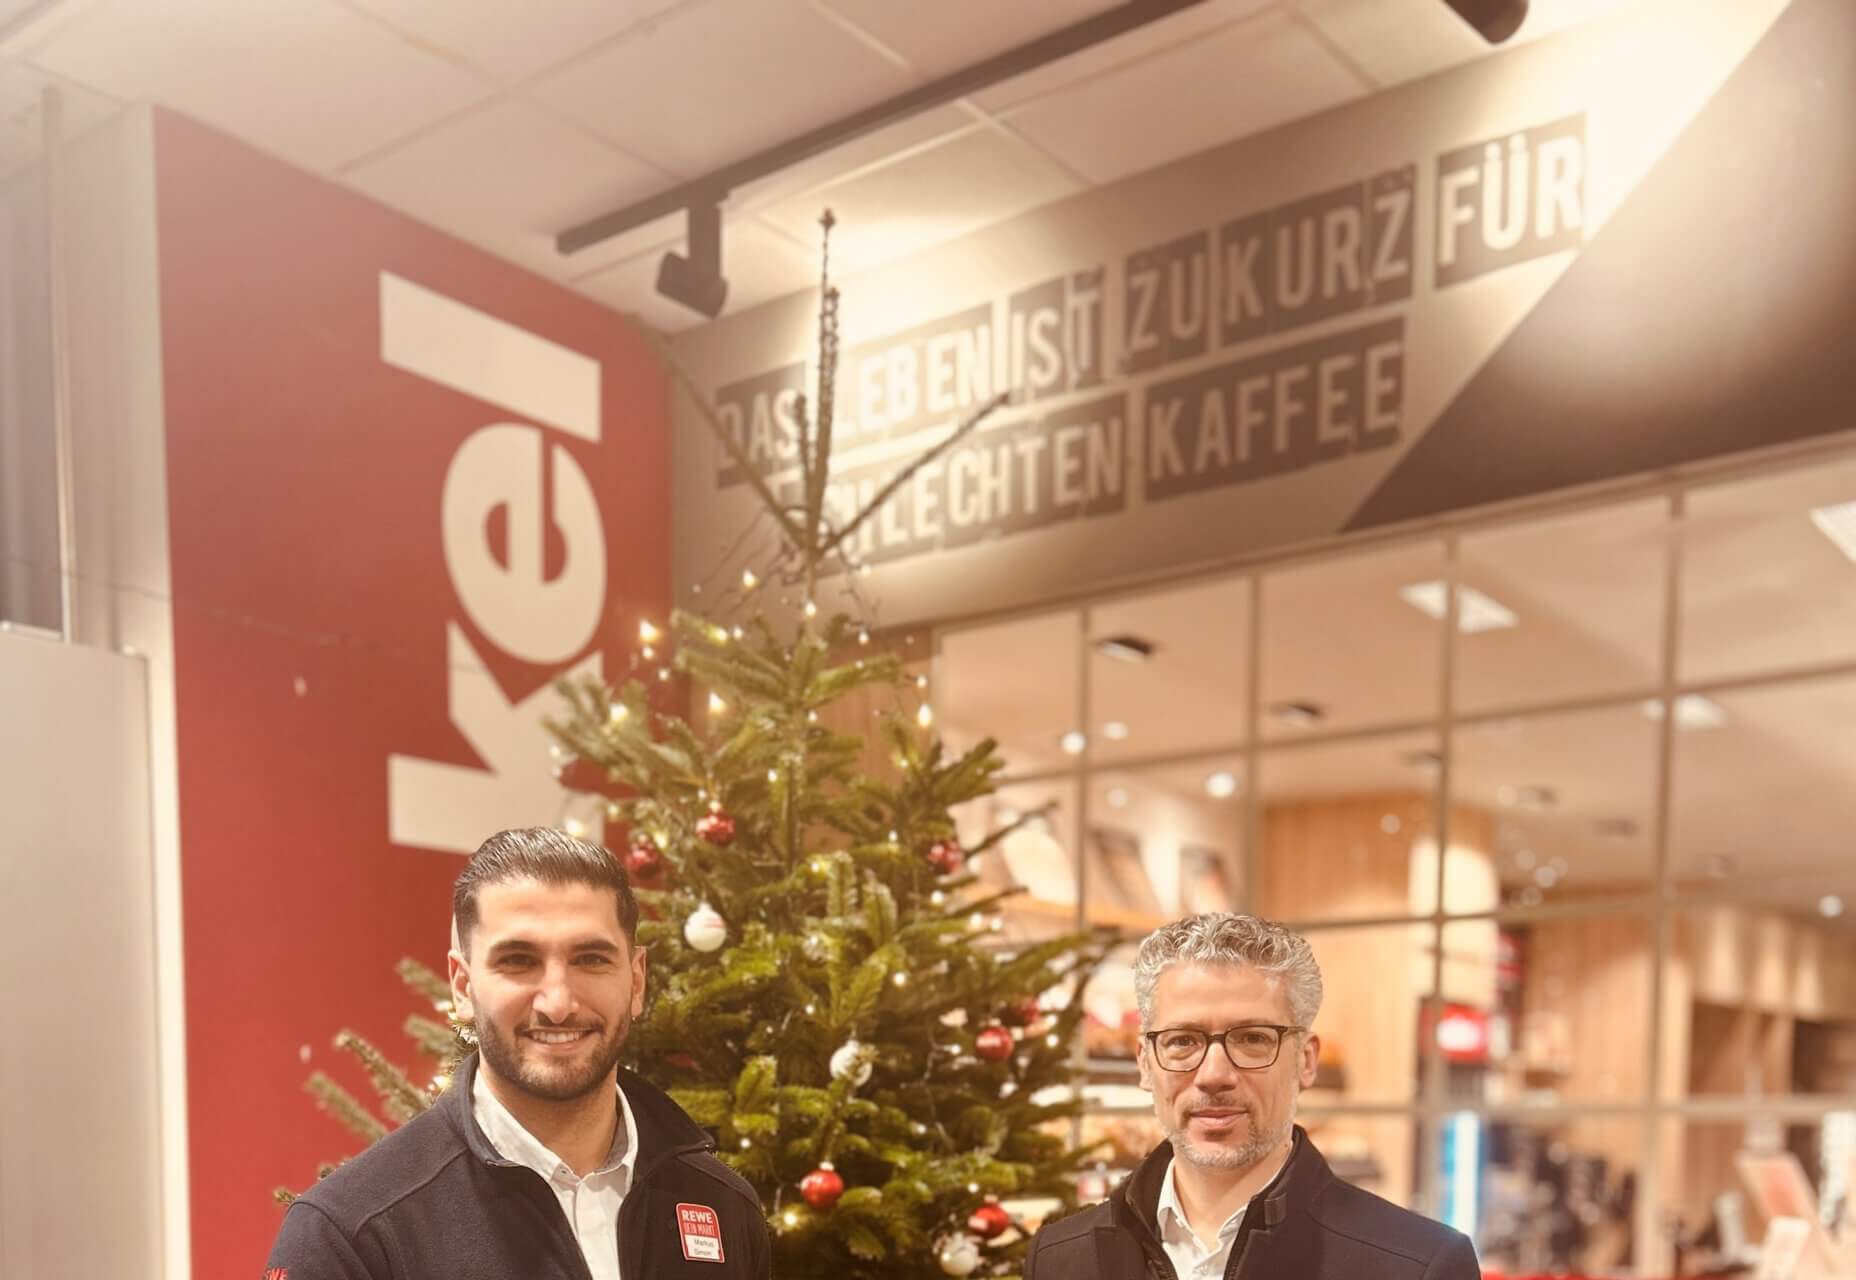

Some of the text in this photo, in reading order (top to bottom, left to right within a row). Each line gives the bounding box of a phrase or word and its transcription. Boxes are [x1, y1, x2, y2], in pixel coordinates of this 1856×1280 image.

[717, 388, 799, 465] DAS
[1010, 284, 1100, 402] IST
[1129, 252, 1206, 351] ZU
[1225, 187, 1412, 325] KURZ
[1438, 132, 1588, 267] FÜR
[1149, 342, 1401, 481] KAFFEE
[681, 1210, 713, 1223] REWE
